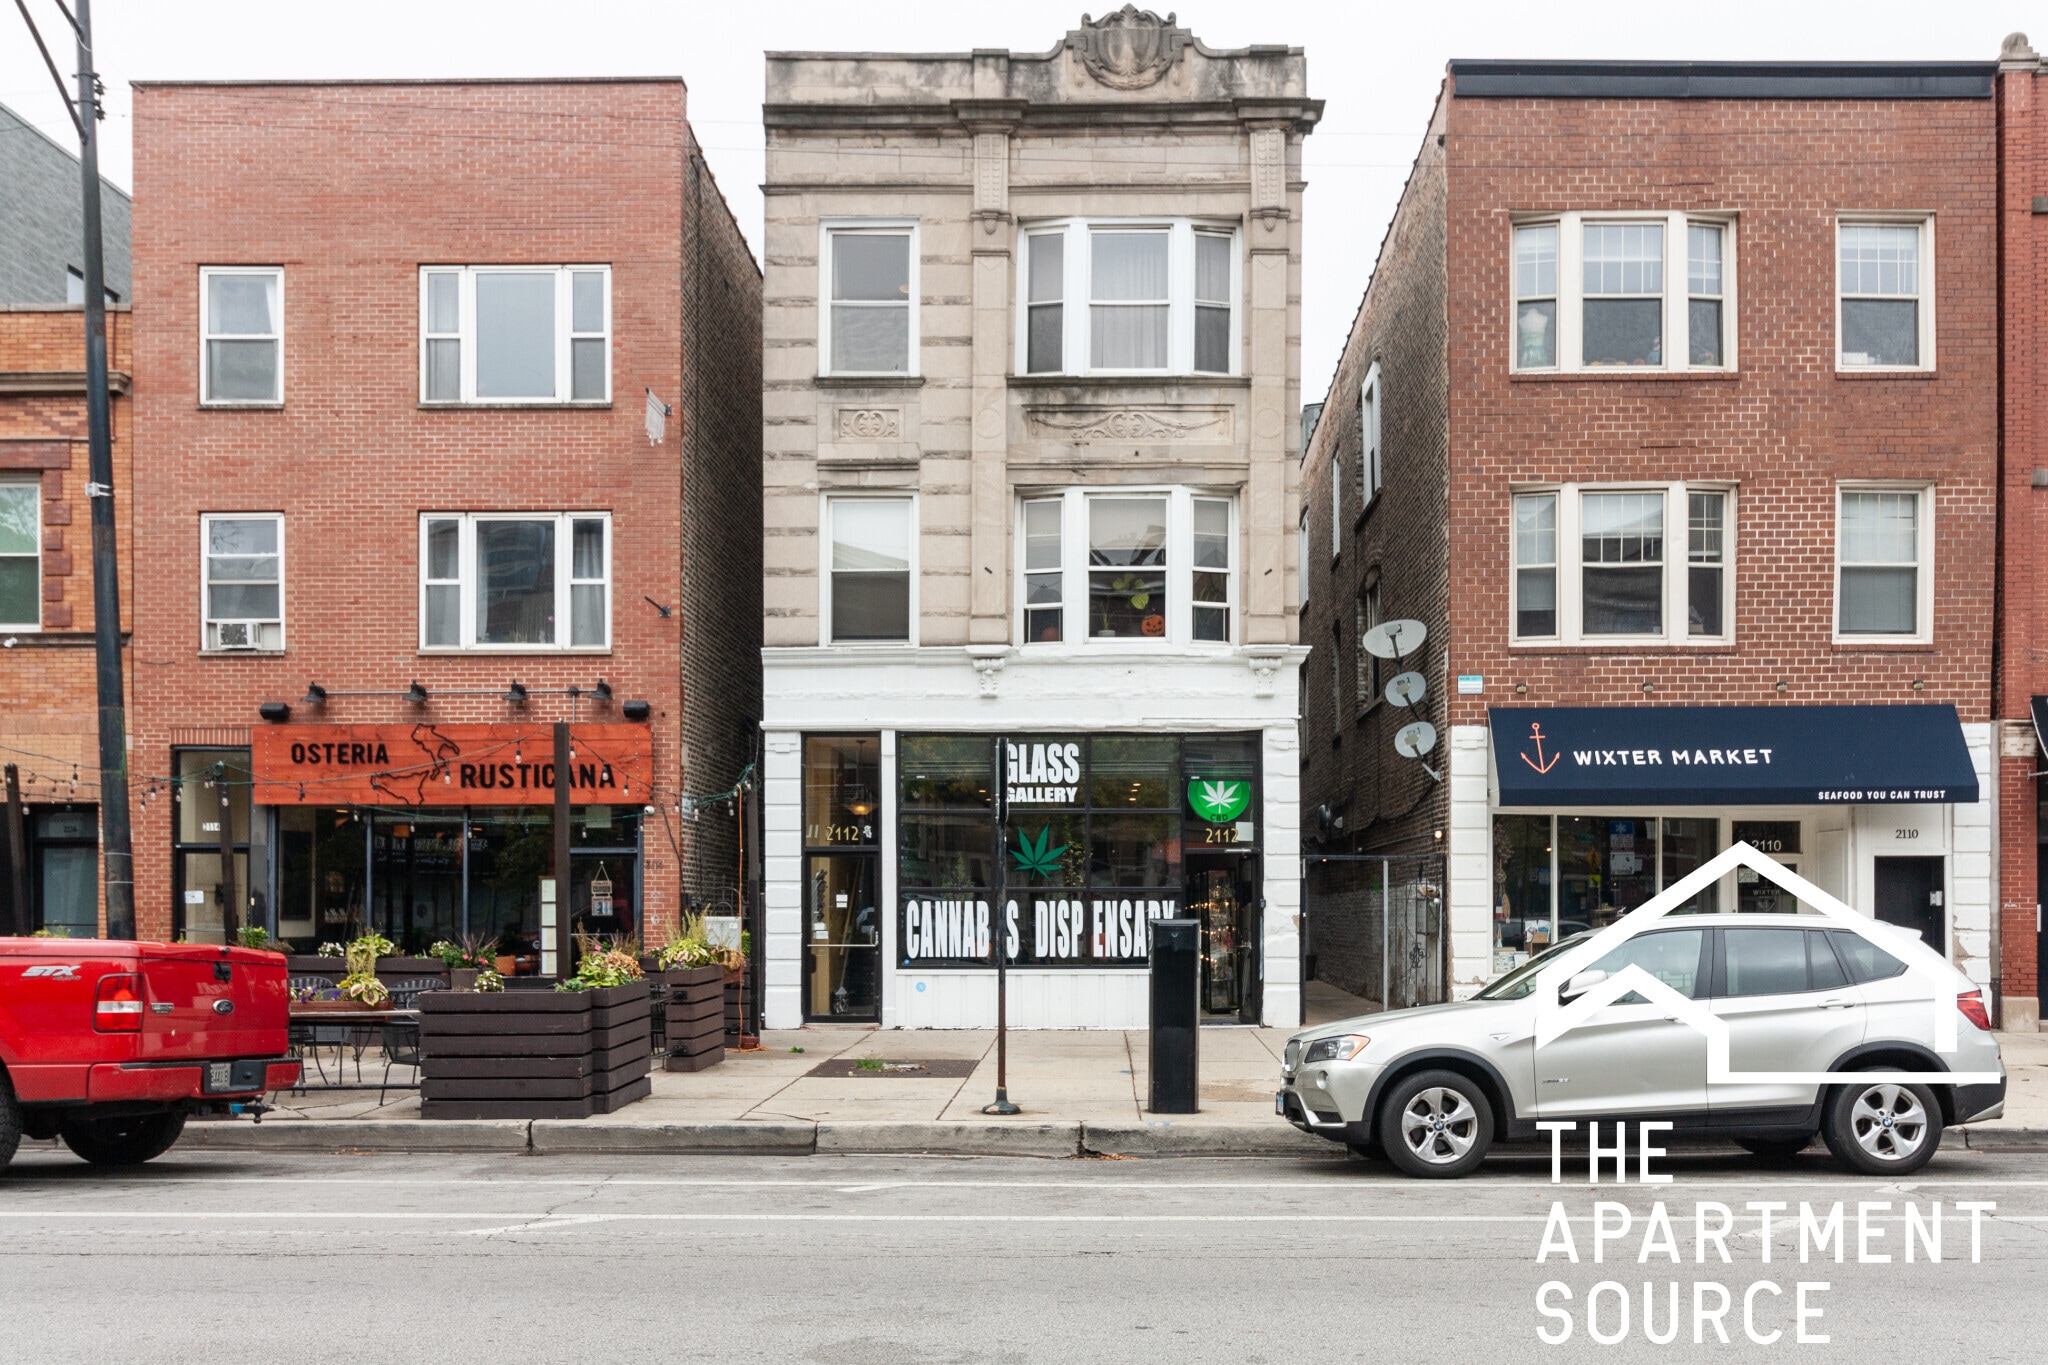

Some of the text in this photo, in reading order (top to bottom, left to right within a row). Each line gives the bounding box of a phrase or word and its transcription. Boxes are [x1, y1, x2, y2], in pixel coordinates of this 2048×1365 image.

[291, 743, 389, 764] OSTERIA
[1573, 748, 1773, 766] WIXTER MARKET
[1007, 743, 1080, 784] GLASS
[1007, 787, 1078, 803] GALLERY
[1818, 790, 1946, 800] SEAFOOD YOU CAN TRUST
[826, 826, 859, 840] 2112
[1205, 828, 1239, 843] 2112
[1896, 829, 1919, 839] 2110
[1751, 840, 1782, 852] 2110
[906, 900, 1020, 958] CANNABS
[21, 966, 81, 976] STX
